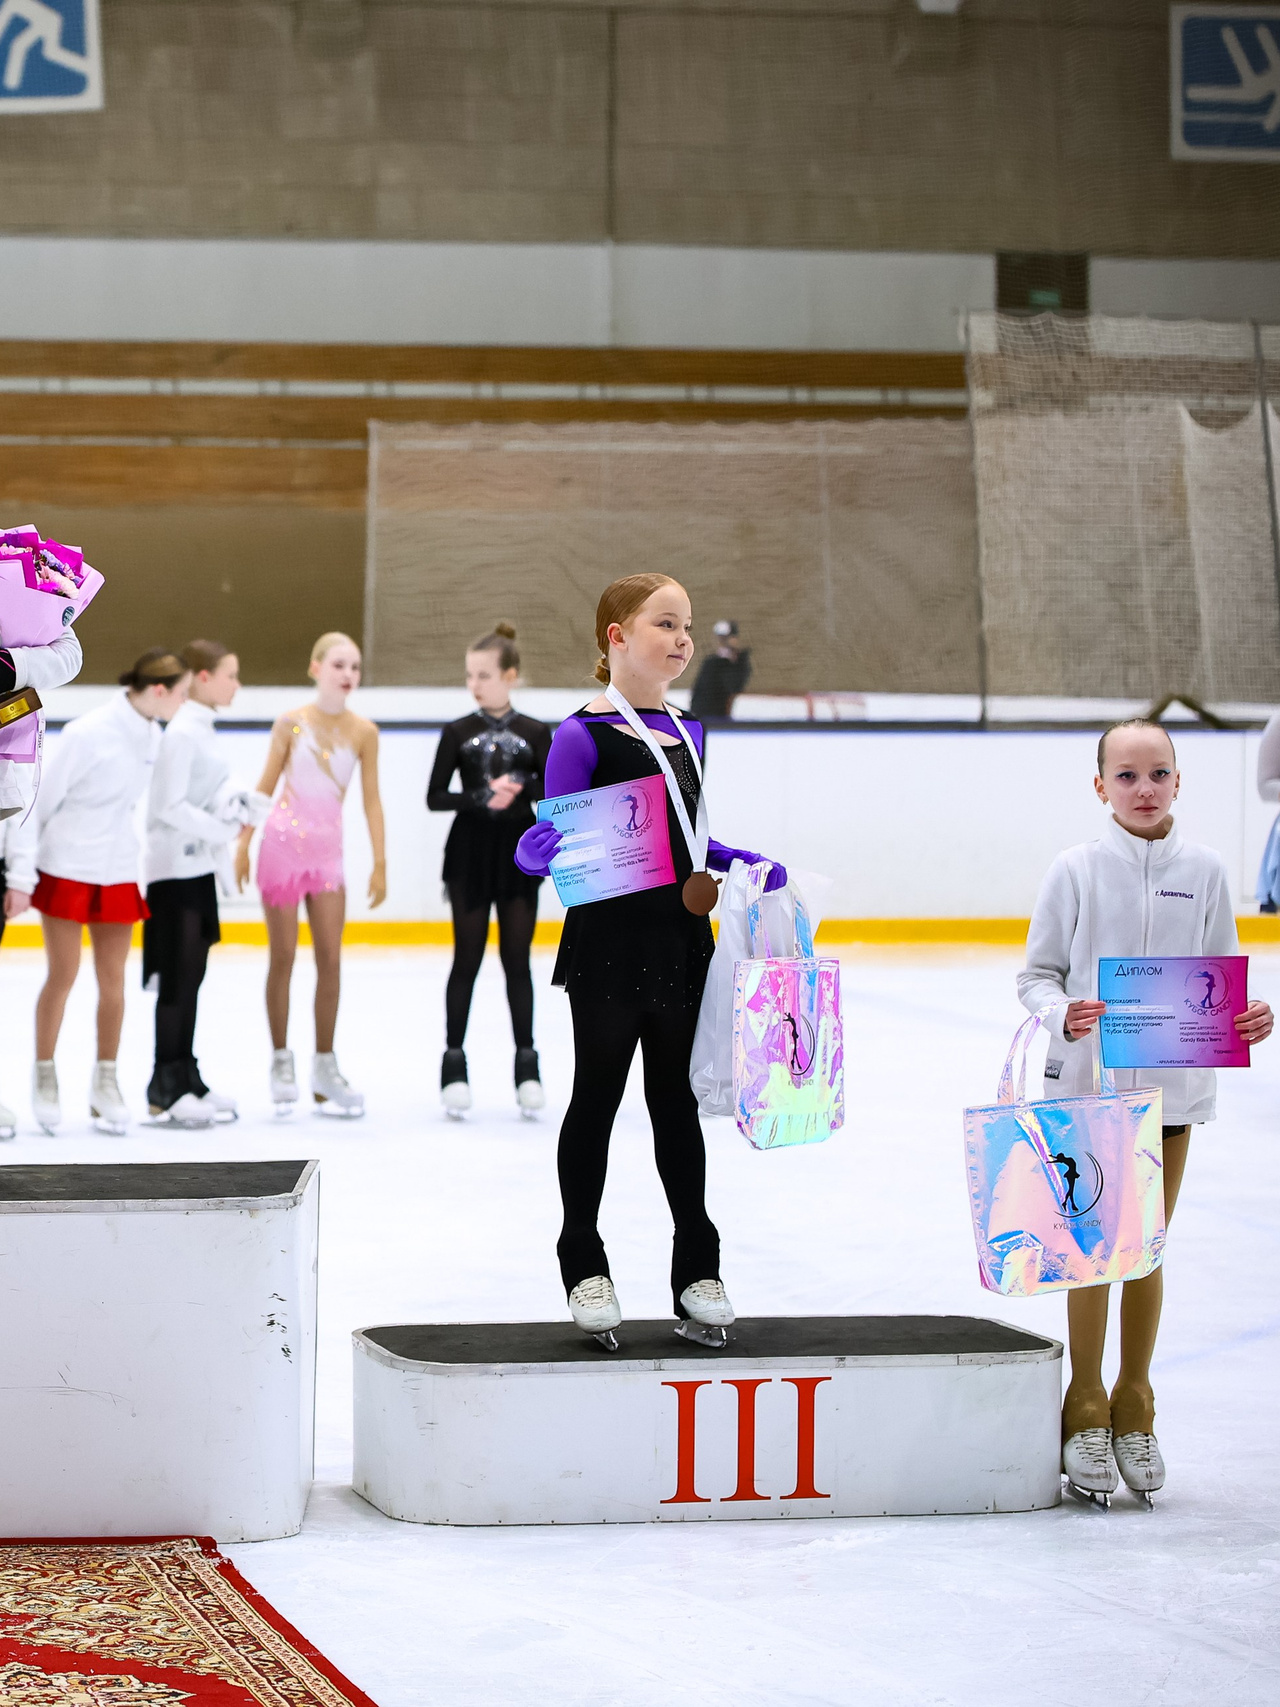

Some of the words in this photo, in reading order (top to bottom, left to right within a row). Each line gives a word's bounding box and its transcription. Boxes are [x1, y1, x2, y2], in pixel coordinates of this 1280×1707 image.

[612, 823, 634, 839] КУБОК
[635, 818, 654, 838] CANDY
[1160, 889, 1194, 900] Архангельск
[1184, 998, 1208, 1017] КУБОК
[1210, 997, 1233, 1017] CANDY
[661, 1376, 830, 1503] III
